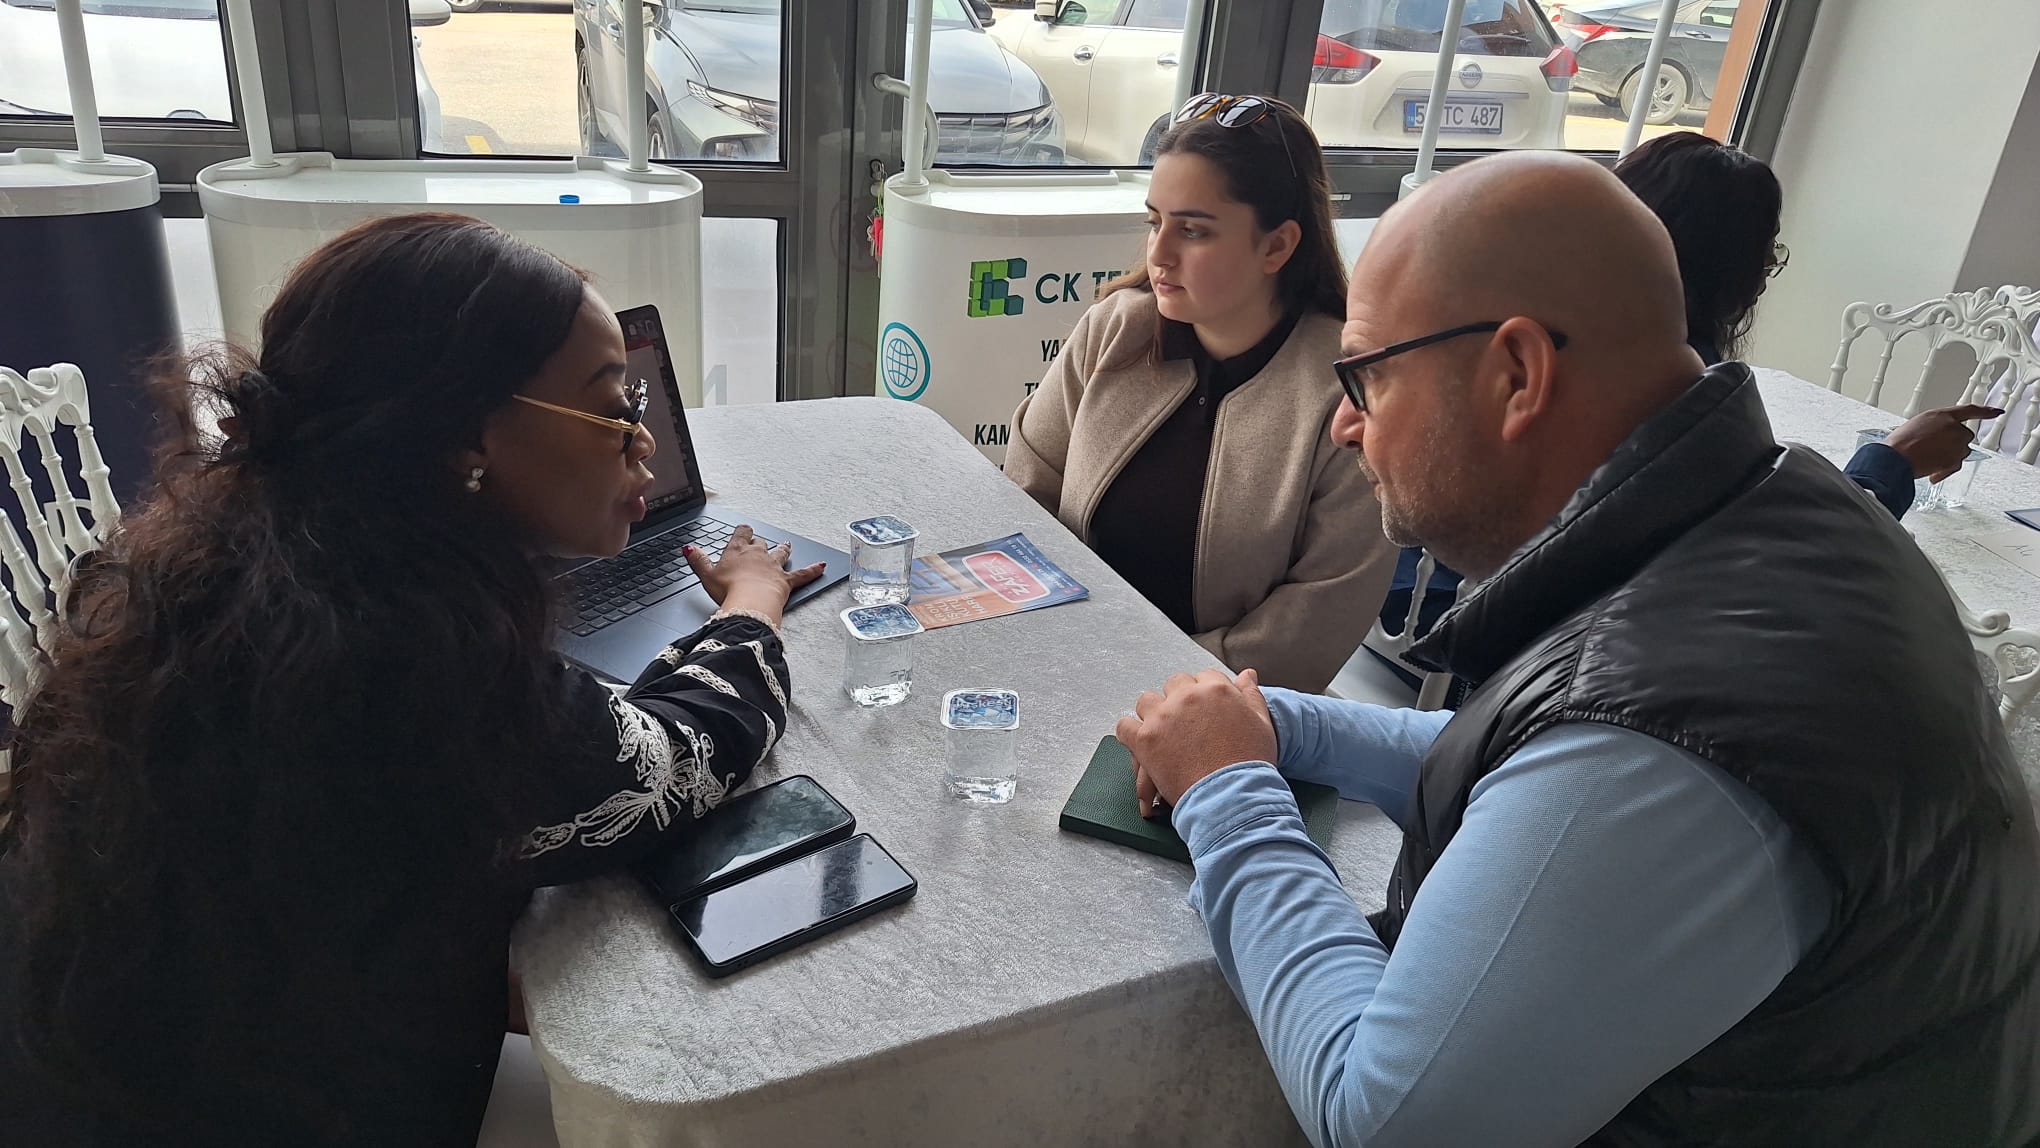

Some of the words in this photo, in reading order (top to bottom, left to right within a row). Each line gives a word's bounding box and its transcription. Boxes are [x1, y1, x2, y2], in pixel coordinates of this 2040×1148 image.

[1444, 106, 1464, 126] TC
[1470, 106, 1499, 127] 487
[1035, 272, 1083, 304] CK
[983, 556, 1031, 596] ZAFER
